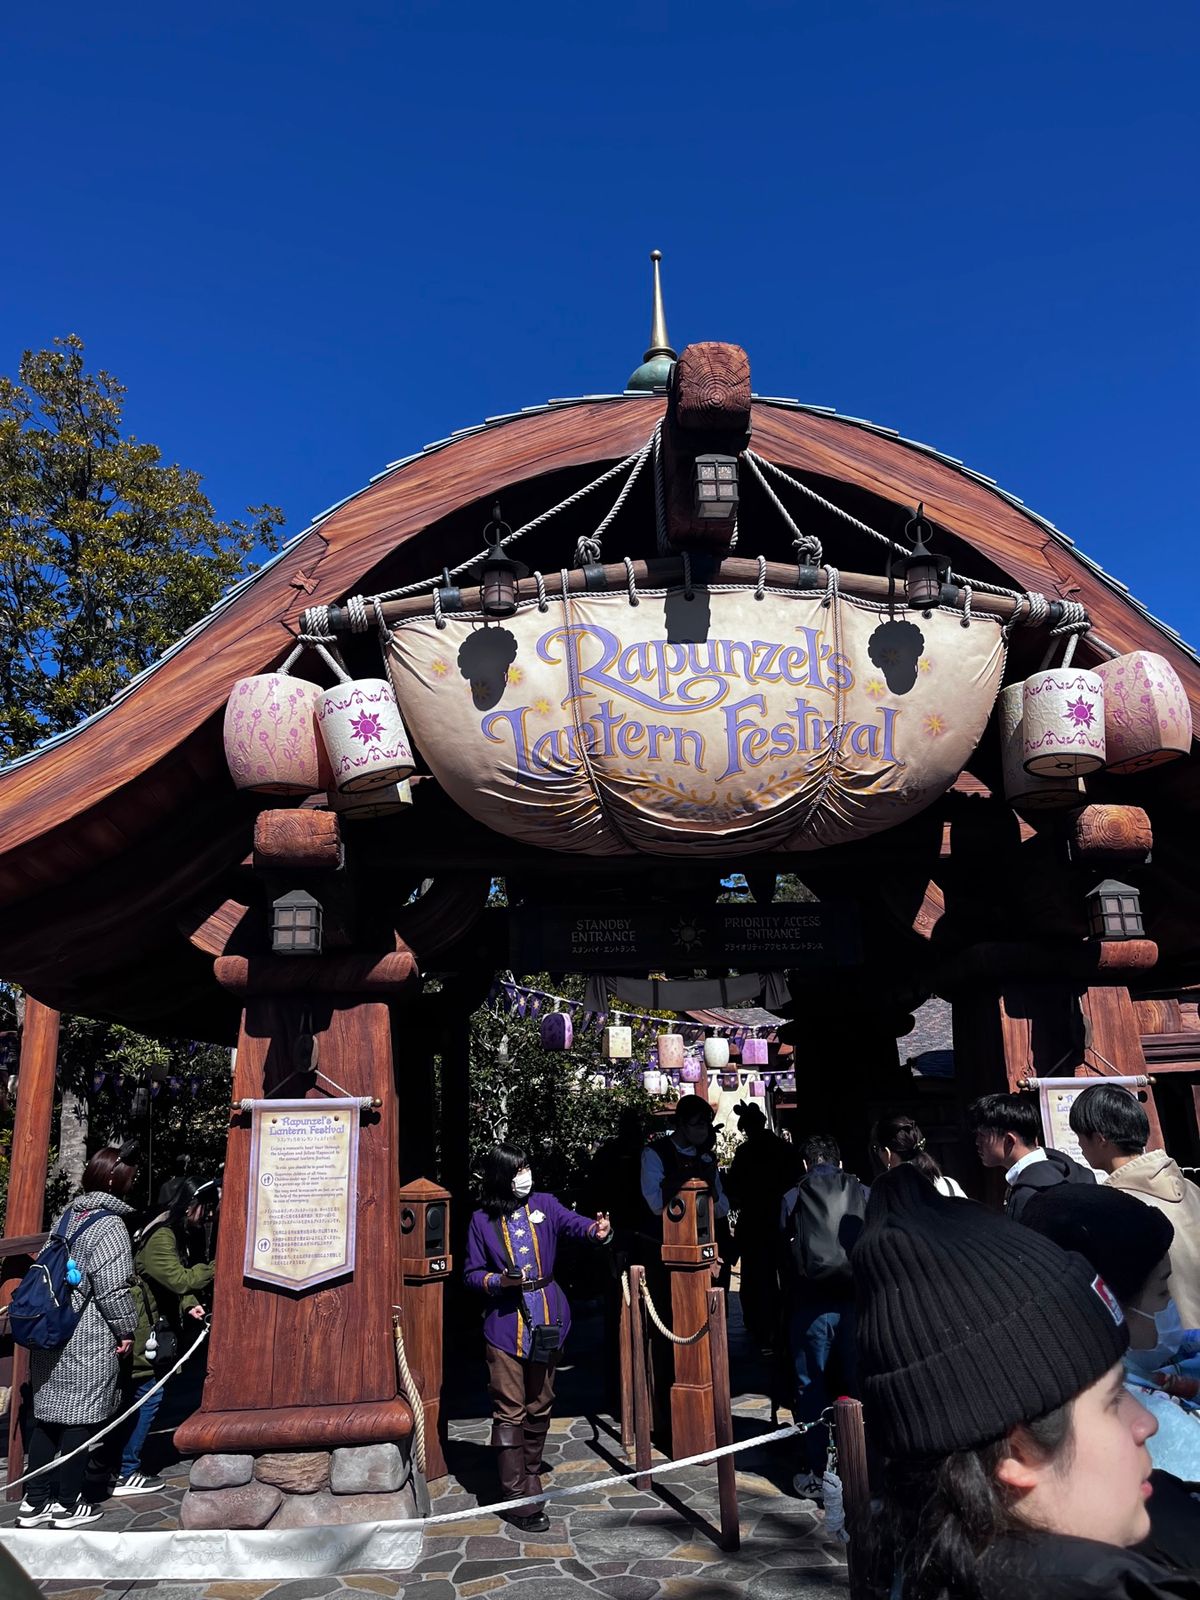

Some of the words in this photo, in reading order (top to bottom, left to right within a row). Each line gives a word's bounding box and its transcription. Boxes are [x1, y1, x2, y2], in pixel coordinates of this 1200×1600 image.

[536, 623, 856, 712] Rapunzel's
[481, 699, 706, 786] Lantern
[714, 693, 906, 784] Festival
[576, 919, 632, 931] STANDBY
[724, 916, 780, 928] PRIORITY
[783, 915, 822, 927] ACCESS
[571, 930, 637, 943] ENTRANCE
[746, 927, 801, 939] ENTRANCE
[281, 1115, 332, 1127] Rapunzel's
[269, 1126, 307, 1136] Lantern
[309, 1124, 345, 1135] Festival
